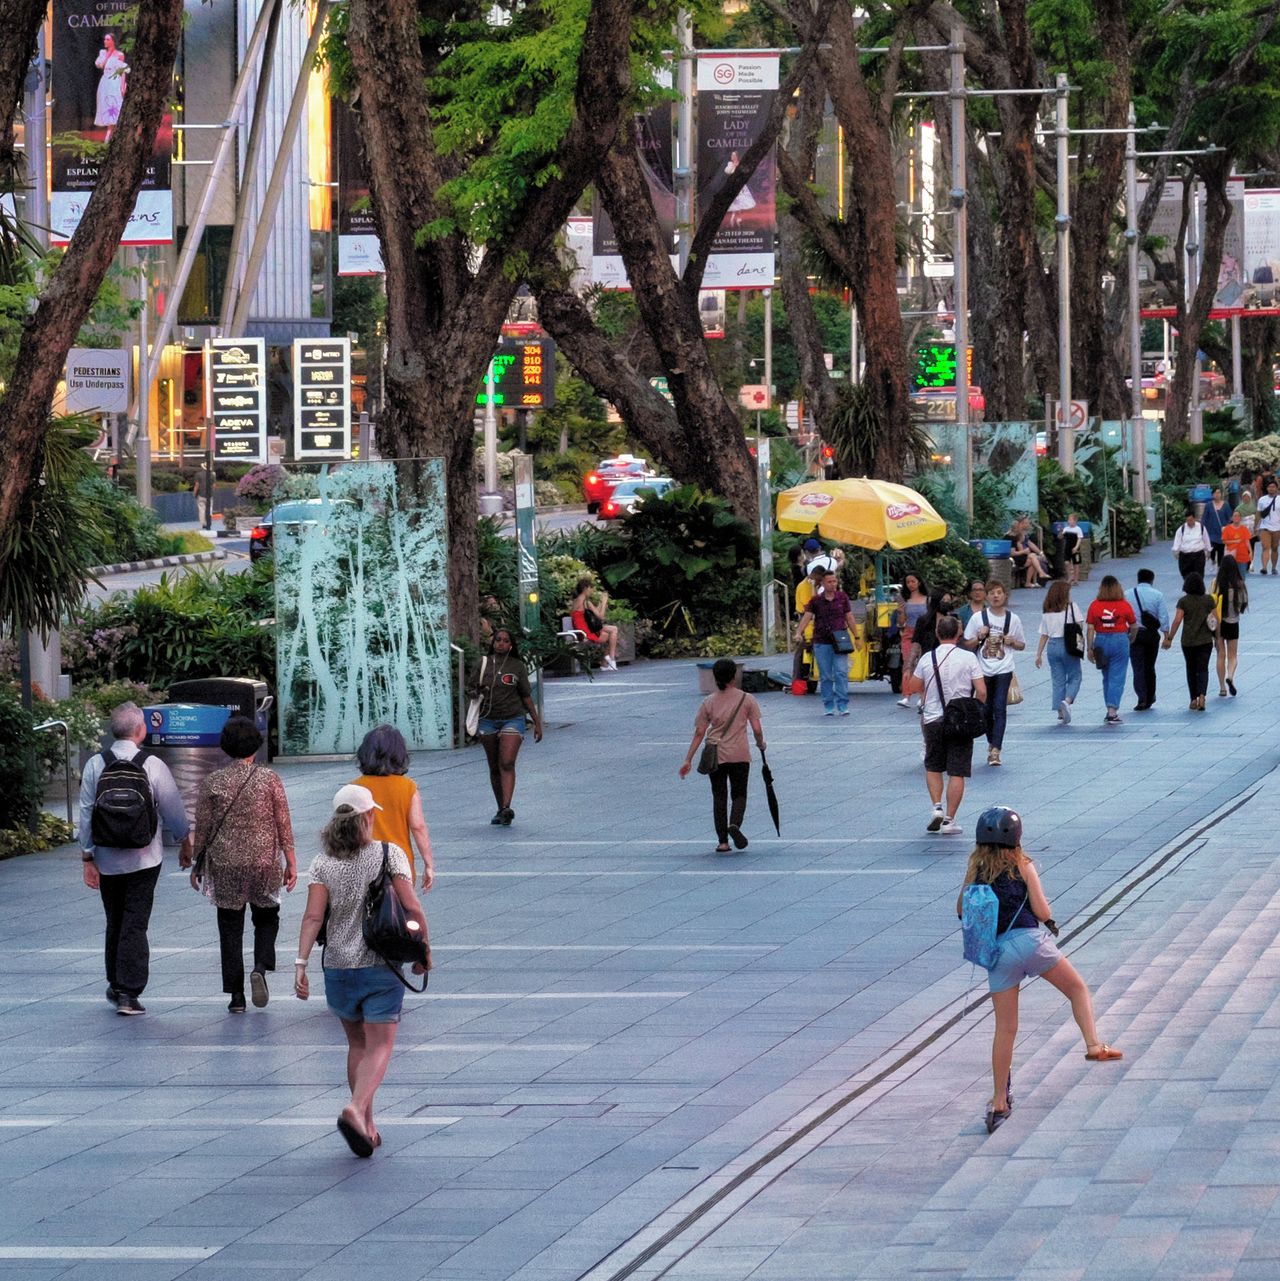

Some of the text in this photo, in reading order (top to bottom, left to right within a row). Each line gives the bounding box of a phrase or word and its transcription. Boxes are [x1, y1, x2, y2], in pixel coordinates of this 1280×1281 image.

[96, 3, 108, 11] OF
[717, 70, 732, 78] SG
[724, 121, 750, 130] LADY
[707, 139, 752, 148] CAMELLI
[74, 367, 120, 375] PEDESTRIANS
[524, 376, 540, 384] 141
[70, 380, 124, 389] Use Underpass
[220, 419, 254, 427] ADEVA
